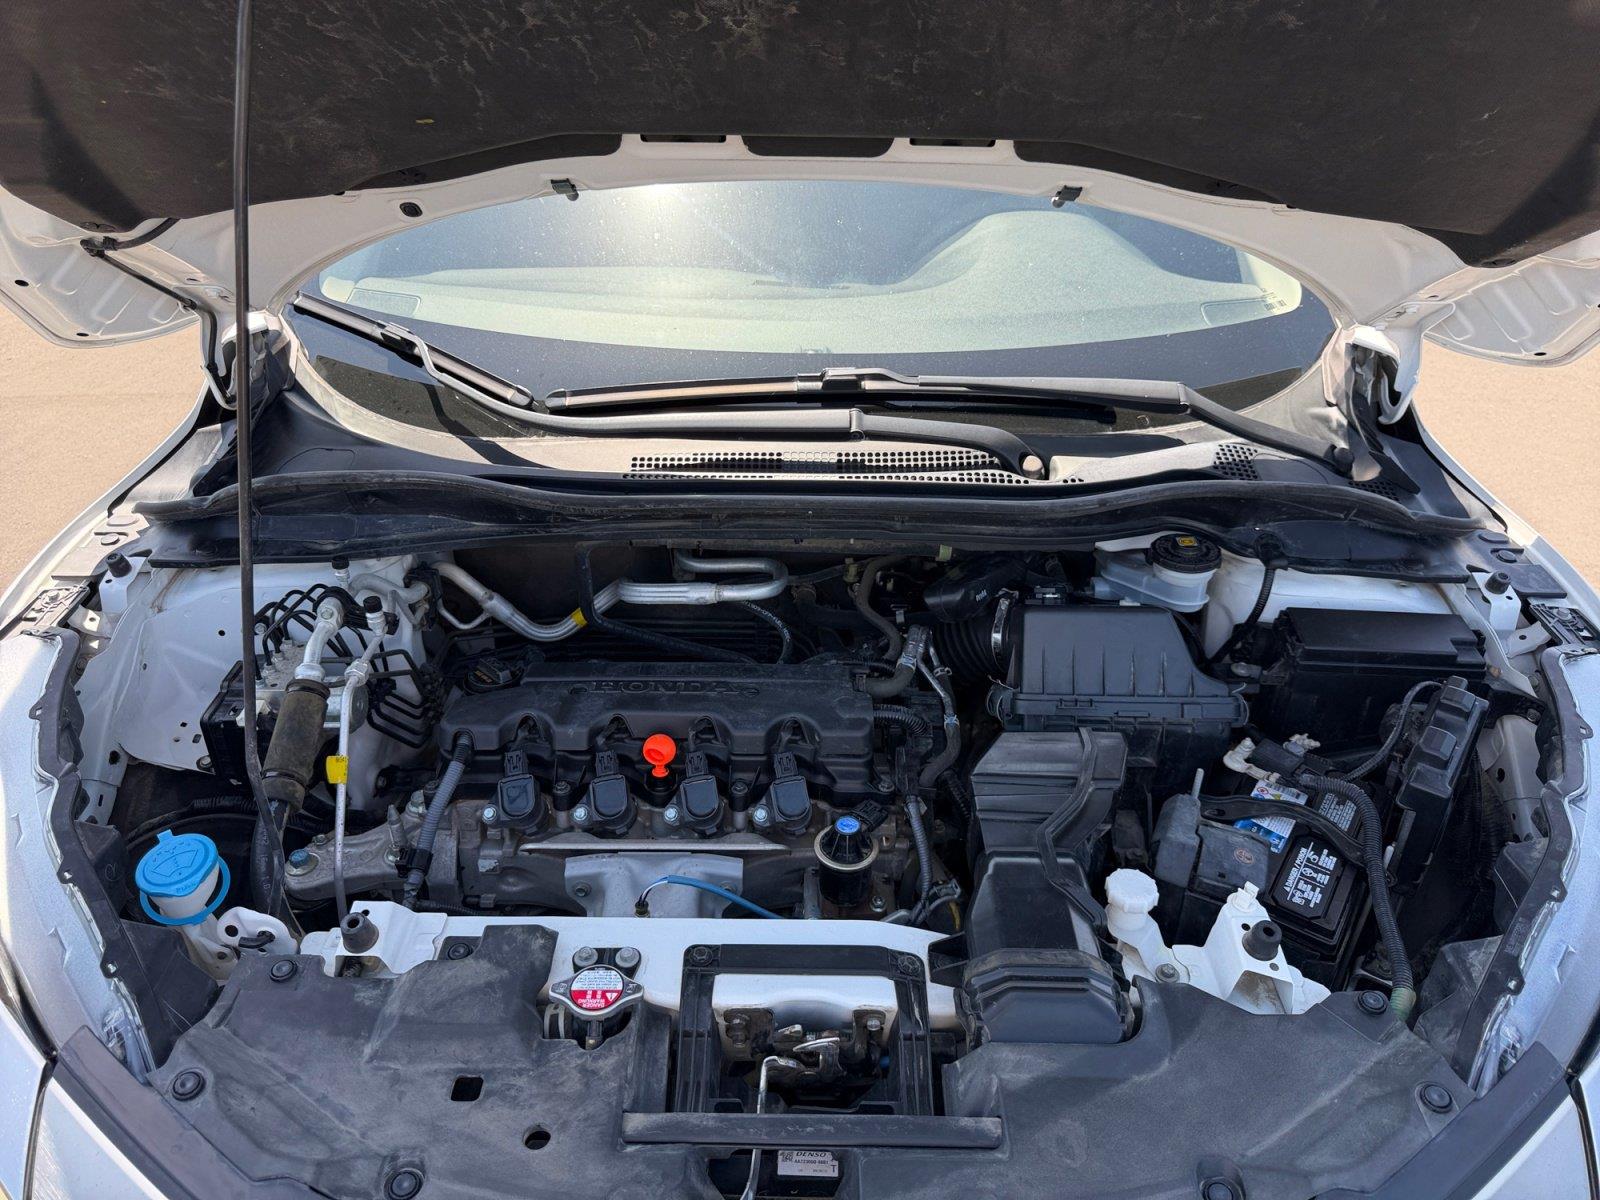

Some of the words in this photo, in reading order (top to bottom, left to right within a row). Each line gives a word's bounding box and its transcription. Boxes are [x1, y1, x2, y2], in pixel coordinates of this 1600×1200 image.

[589, 680, 740, 695] HONDA
[1284, 867, 1299, 888] DANGER
[830, 1164, 838, 1173] T
